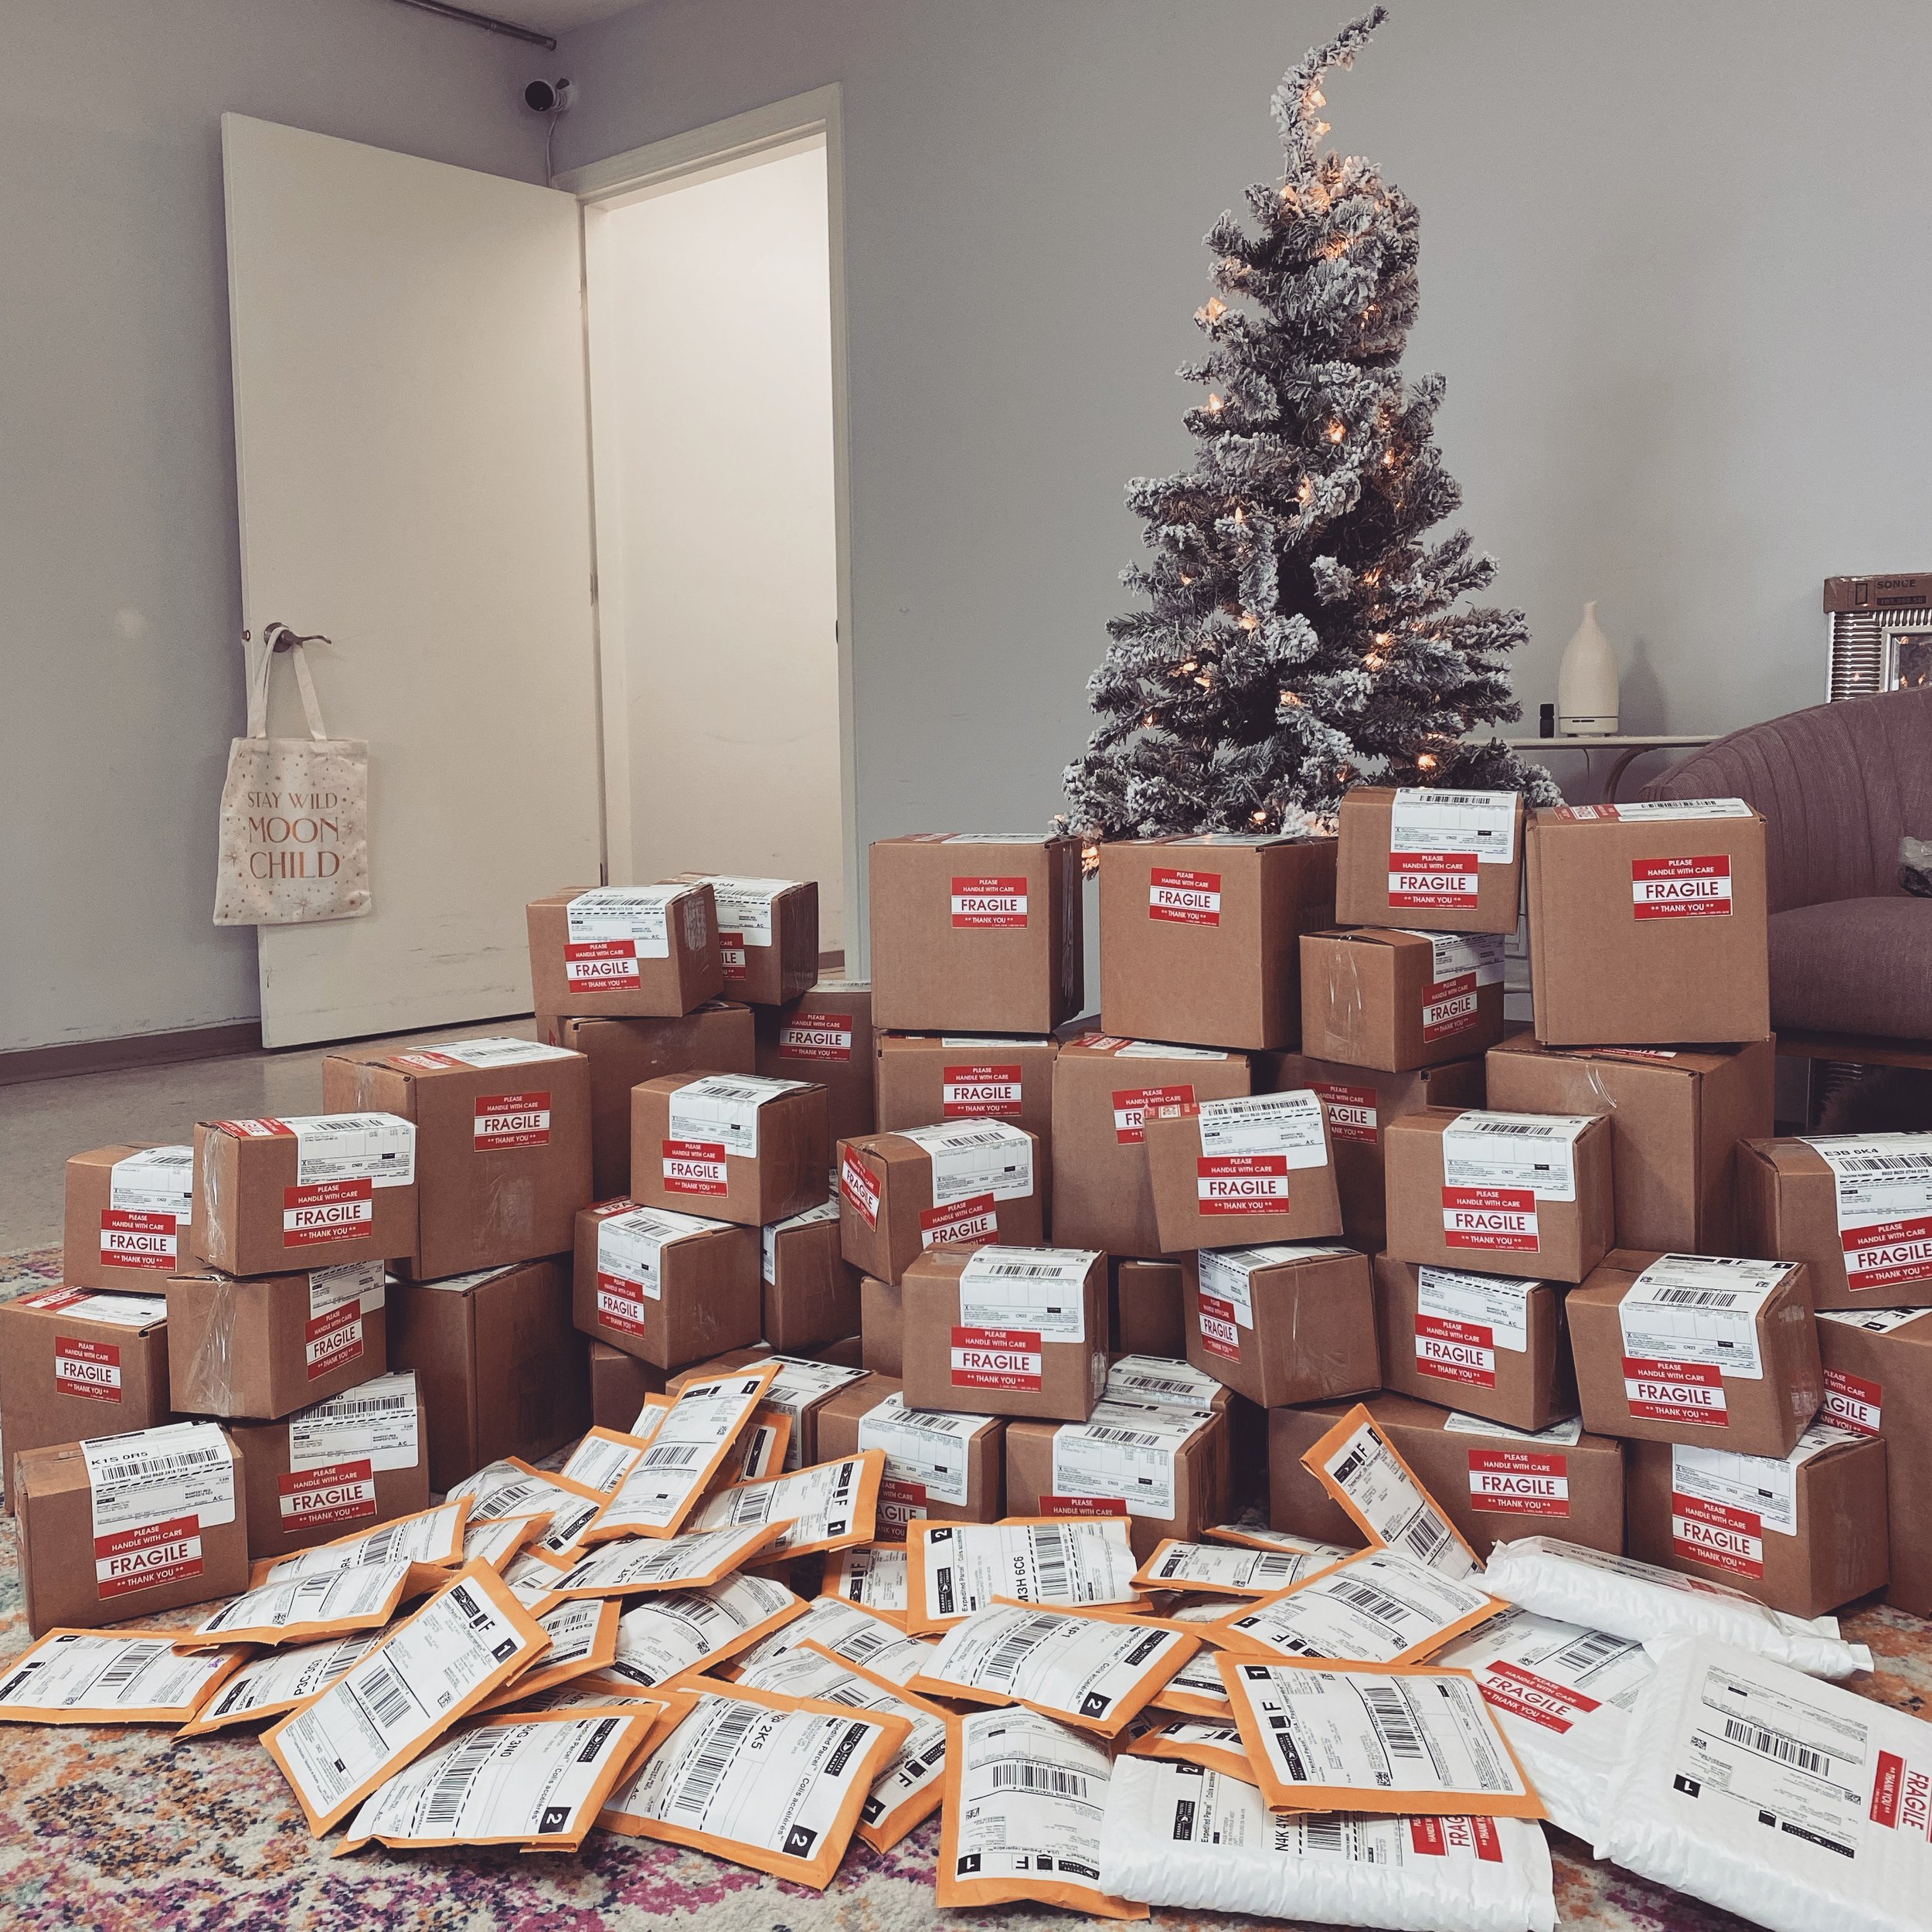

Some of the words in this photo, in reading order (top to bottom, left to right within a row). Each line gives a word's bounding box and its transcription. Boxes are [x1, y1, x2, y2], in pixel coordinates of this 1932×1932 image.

[247, 791, 281, 809] STAY
[289, 792, 338, 810] WILD
[248, 817, 339, 843] MOON
[250, 851, 340, 879] CHILD
[1400, 876, 1465, 890] FRAGILE
[1645, 881, 1718, 898] FRAGILE
[961, 899, 1017, 911] FRAGILE
[1158, 890, 1210, 908] FRAGILE
[575, 961, 629, 976] FRAGILE
[1430, 996, 1470, 1022] FRAGILE
[788, 1031, 842, 1045] FRAGILE
[954, 1086, 1011, 1100] FRAGILE
[484, 1114, 540, 1131] FRAGILE
[495, 1135, 515, 1144] THANK
[671, 1162, 719, 1179] FRAGILE
[317, 1184, 338, 1192] PLEASE
[847, 1169, 872, 1210] FRAGILE
[1209, 1180, 1276, 1195] FRAGILE
[298, 1194, 323, 1203] HANDLE
[295, 1204, 360, 1226] FRAGILE
[1455, 1213, 1525, 1230] FRAGILE
[308, 1229, 331, 1238] THANK
[332, 1226, 347, 1235] YOU
[932, 1218, 988, 1243] FRAGILE
[110, 1234, 166, 1251] FRAGILE
[1470, 1235, 1495, 1243] THANK
[1495, 1236, 1512, 1245] YOU
[1857, 1242, 1932, 1268] FRAGILE
[603, 1295, 638, 1318] FRAGILE
[1203, 1318, 1233, 1341] FRAGILE
[314, 1325, 355, 1358] FRAGILE
[964, 1337, 990, 1345] HANDLE
[963, 1352, 1029, 1371] FRAGILE
[1425, 1341, 1483, 1366] FRAGILE
[63, 1362, 111, 1383] FRAGILE
[1657, 1362, 1682, 1371] PLEASE
[975, 1374, 998, 1383] THANK
[1637, 1369, 1665, 1378] HANDLE
[1685, 1373, 1705, 1382] CARE
[746, 1382, 753, 1393] 1
[1638, 1383, 1712, 1405] FRAGILE
[1655, 1406, 1680, 1416] THANK
[1681, 1409, 1699, 1417] YOU
[1483, 1461, 1511, 1469] HANDLE
[1504, 1453, 1528, 1461] PLEASE
[1482, 1475, 1555, 1495] FRAGILE
[292, 1485, 362, 1511] FRAGILE
[1497, 1498, 1522, 1507] THANK
[1523, 1500, 1541, 1509] YOU
[111, 1538, 141, 1551] HANDLE
[142, 1533, 161, 1543] WITH
[162, 1528, 182, 1539] CARE
[133, 1525, 159, 1537] PLEASE
[1683, 1522, 1750, 1555] FRAGILE
[110, 1543, 188, 1575] FRAGILE
[1014, 1556, 1026, 1575] 6C6
[127, 1573, 155, 1586] THANK
[155, 1568, 173, 1579] YOU
[478, 1620, 496, 1632] F
[498, 1645, 511, 1657] 1
[1087, 1699, 1102, 1709] 2
[1485, 1676, 1570, 1716] FRAGILE
[1262, 1702, 1281, 1711] F
[751, 1725, 773, 1750] 2K5
[549, 1768, 562, 1784] Colis
[1884, 1773, 1895, 1794] THANK
[796, 1777, 810, 1797] Colis
[1684, 1781, 1693, 1791] 1
[1881, 1794, 1893, 1808] YOU
[1903, 1770, 1929, 1831] FRAGILE
[546, 1813, 563, 1824] 2
[791, 1833, 808, 1847] 2
[1445, 1816, 1471, 1847] FRAG
[1275, 1831, 1289, 1852] N4K
[966, 1857, 975, 1870] 1
[1015, 1856, 1029, 1870] F
